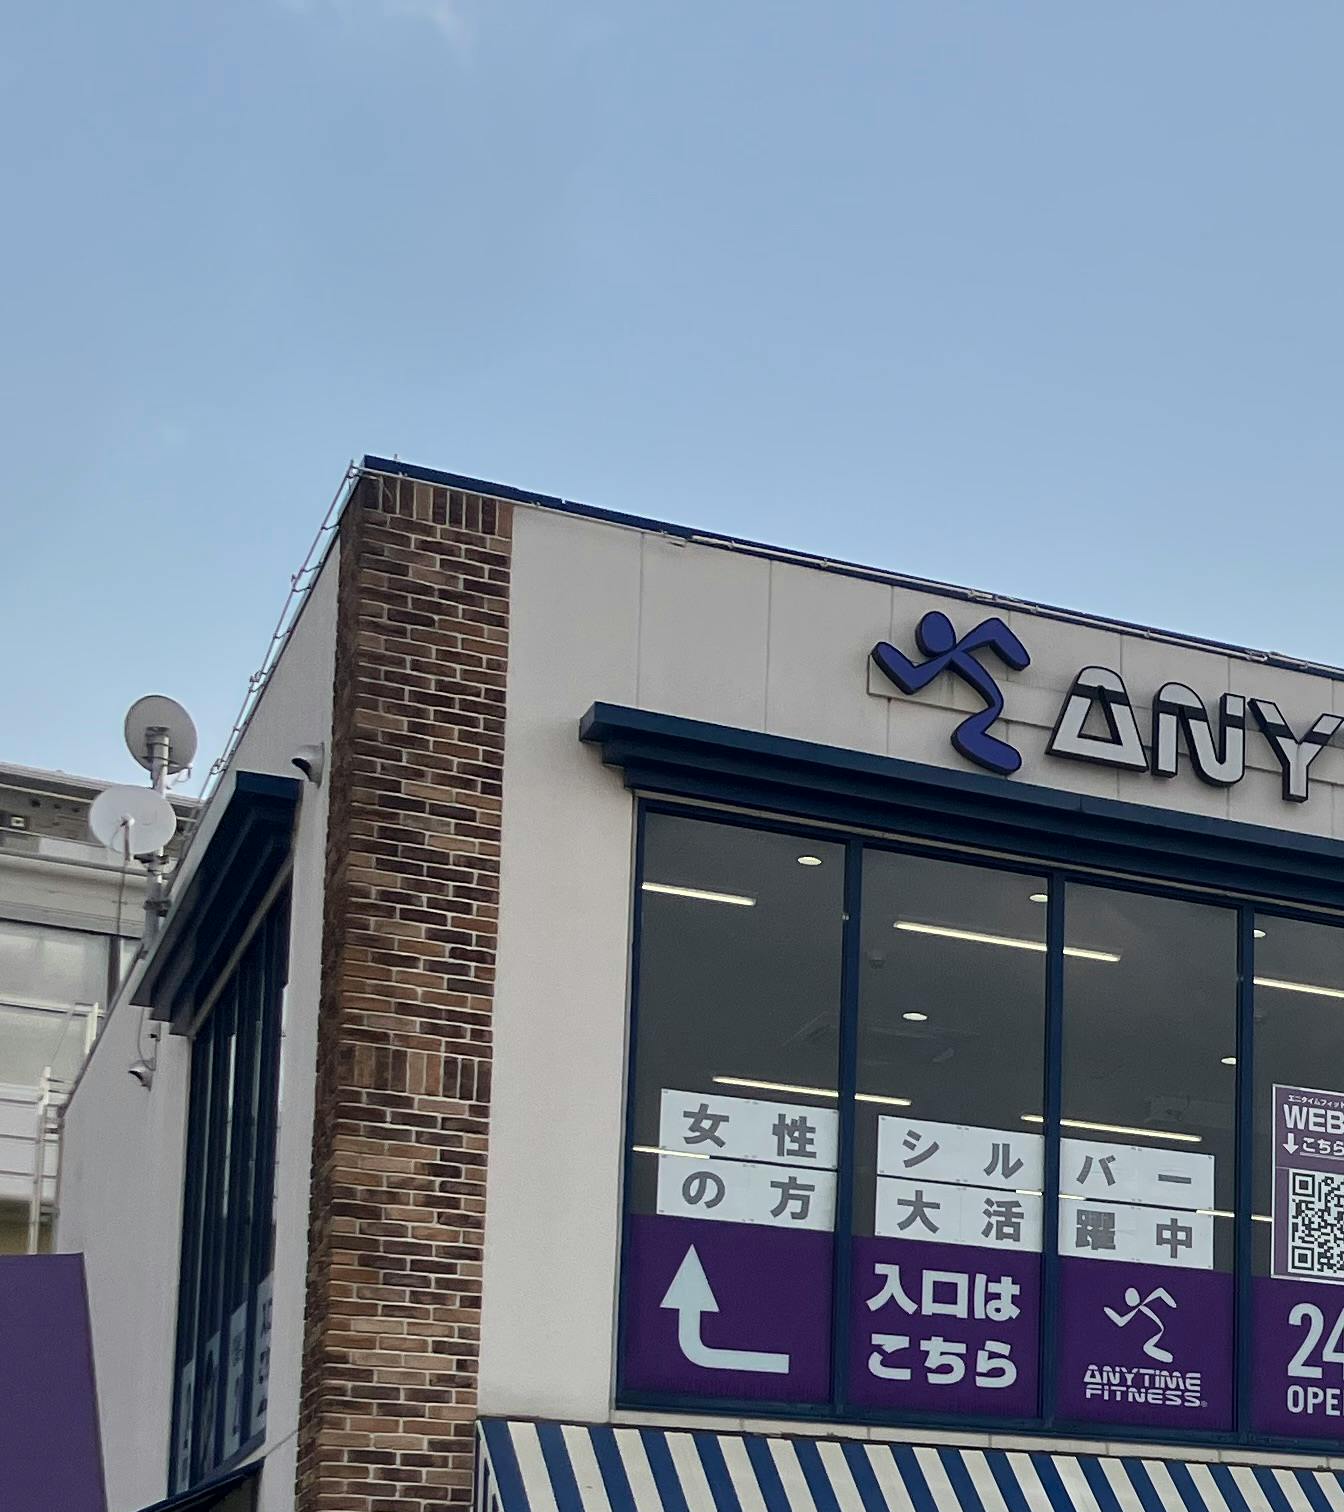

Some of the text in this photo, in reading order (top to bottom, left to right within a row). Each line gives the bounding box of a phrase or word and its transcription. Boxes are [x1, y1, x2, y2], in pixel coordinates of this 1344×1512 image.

[682, 1103, 818, 1160] 女性
[680, 1169, 816, 1222] の方
[866, 1263, 1022, 1322] 入口は
[868, 1334, 1019, 1388] こちら
[1083, 1364, 1201, 1391] ANYTIME
[1085, 1384, 1201, 1408] FITNESS
